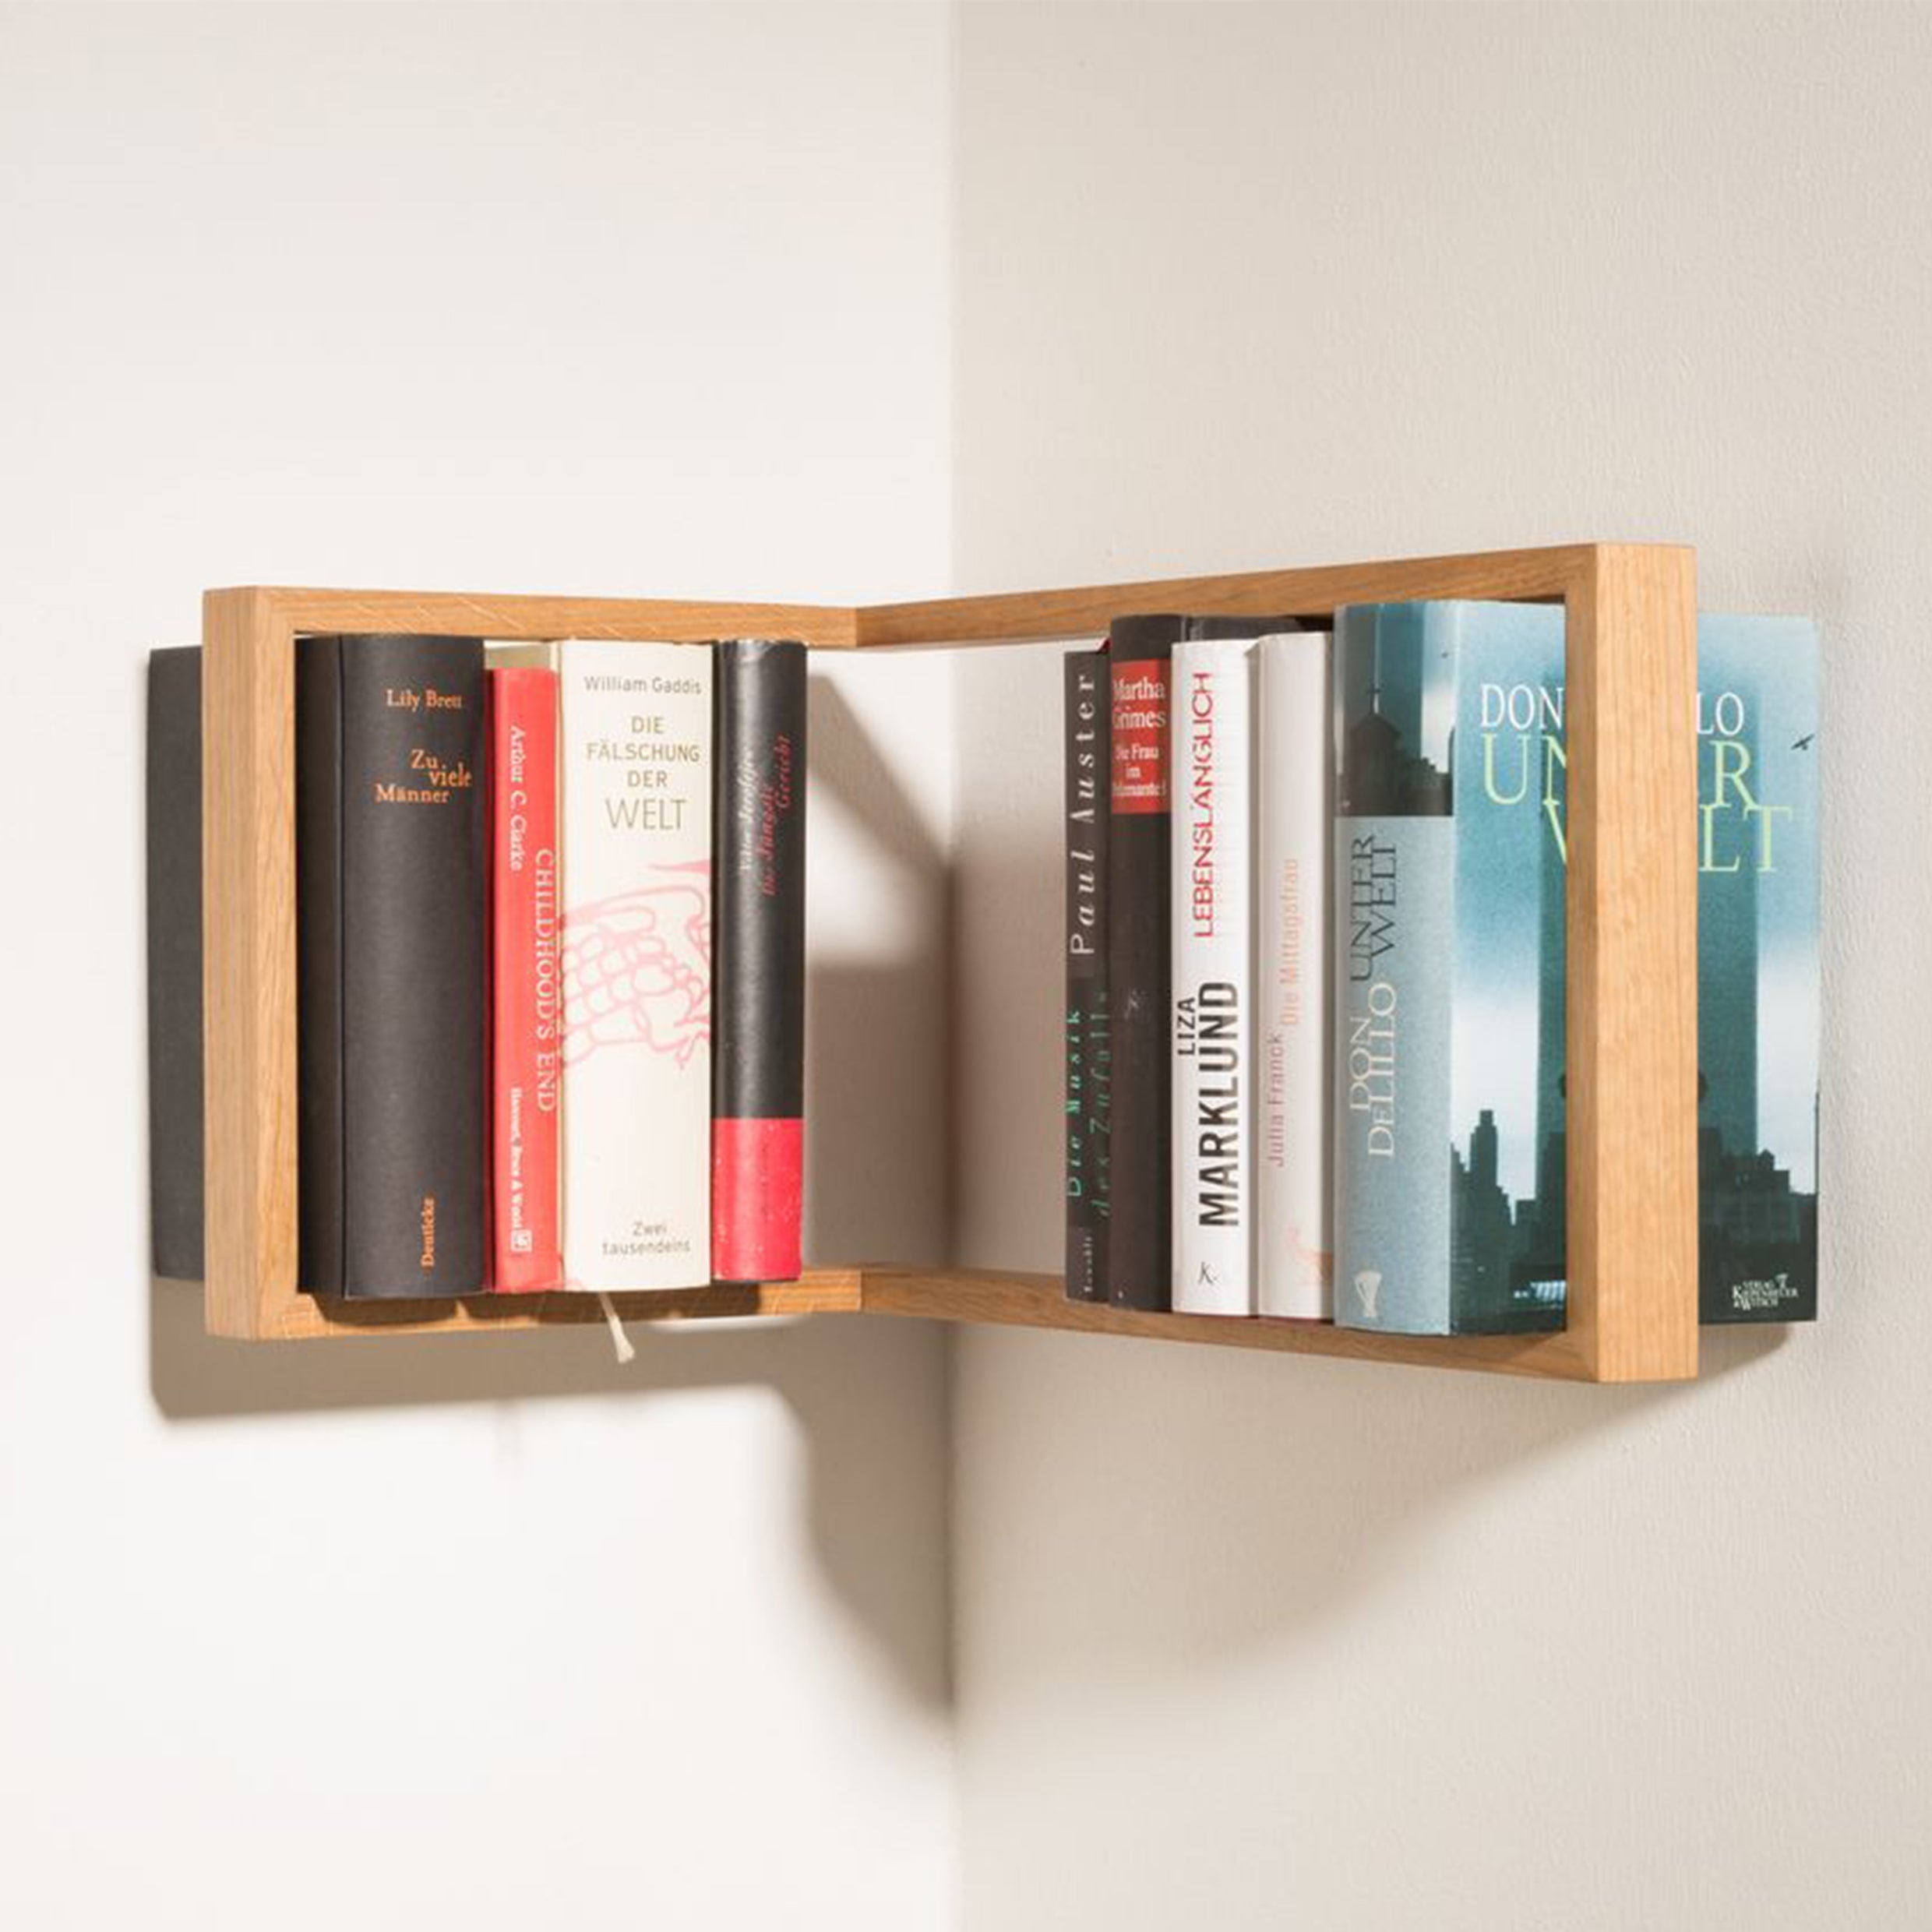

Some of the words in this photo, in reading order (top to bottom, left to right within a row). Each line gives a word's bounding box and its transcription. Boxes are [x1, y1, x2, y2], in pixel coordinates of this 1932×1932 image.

[386, 689, 420, 712] Lily
[583, 676, 647, 692] William
[652, 677, 702, 694] Gaddis
[1112, 676, 1166, 700] Martha
[1481, 684, 1564, 730] DON
[510, 725, 527, 783] Arthur
[586, 740, 701, 763] FÄLSCHUNG
[630, 716, 665, 735] DIE
[1070, 675, 1095, 823] Auster
[411, 749, 439, 769] Zu
[429, 763, 472, 787] viele
[626, 770, 668, 788] DER
[375, 782, 450, 803] Männer
[605, 797, 686, 830] WELT
[1190, 672, 1214, 938] LEBENSLÄNGLICH
[510, 815, 527, 871] Clarke
[1070, 849, 1095, 955] Paul
[1278, 858, 1303, 985] Mittagsfrau
[1349, 834, 1373, 982] UNTER
[1369, 843, 1396, 958] WELT
[534, 848, 556, 1040] CHILDHOOD'S
[1176, 996, 1196, 1056] LIZA
[1279, 992, 1299, 1025] Die
[536, 1052, 556, 1112] END
[1265, 1032, 1285, 1106] Franck
[1349, 1014, 1370, 1112] DON
[1197, 982, 1239, 1227] MARKLUND
[1066, 1134, 1082, 1197] Die
[1265, 1114, 1285, 1168] Julia
